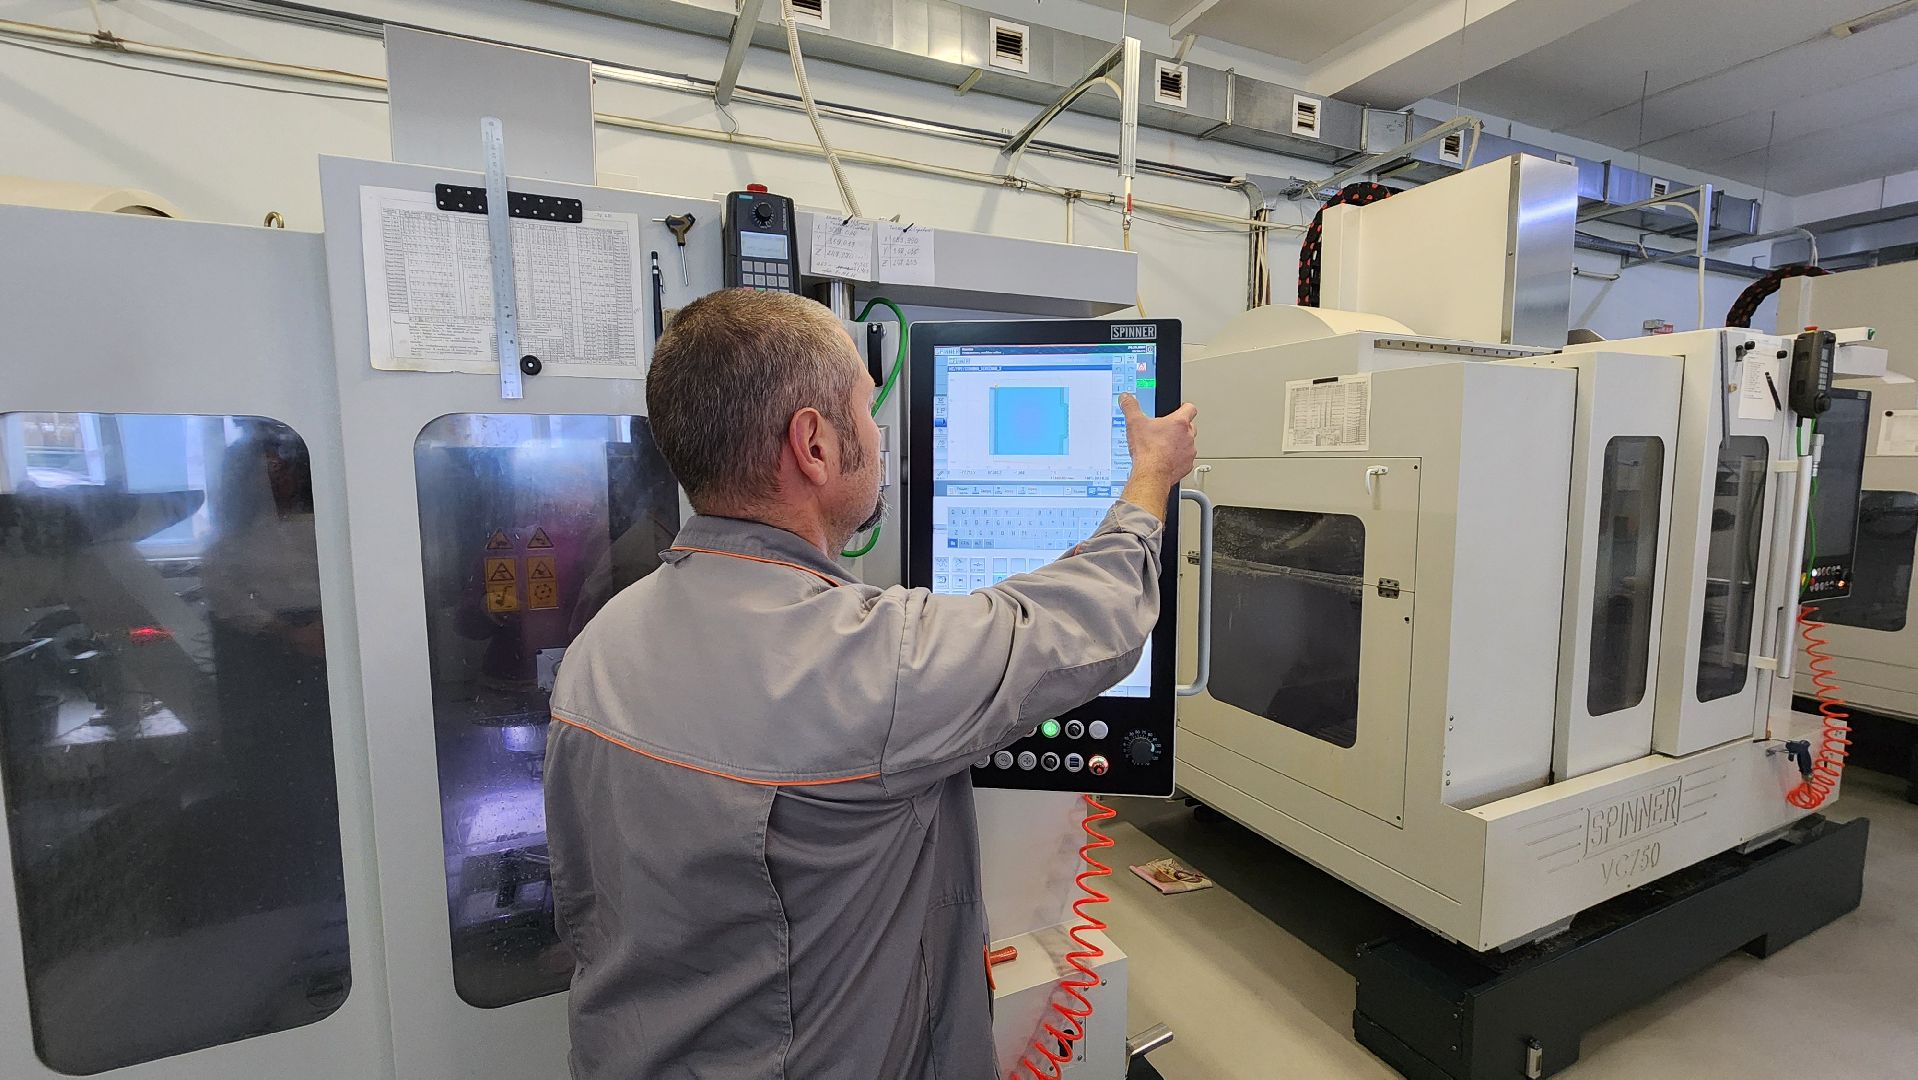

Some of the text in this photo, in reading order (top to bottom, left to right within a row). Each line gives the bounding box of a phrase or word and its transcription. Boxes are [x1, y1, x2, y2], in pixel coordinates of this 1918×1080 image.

[1112, 326, 1155, 338] SPINNER
[1591, 785, 1678, 847] SPINNER
[1601, 841, 1661, 885] VC750
